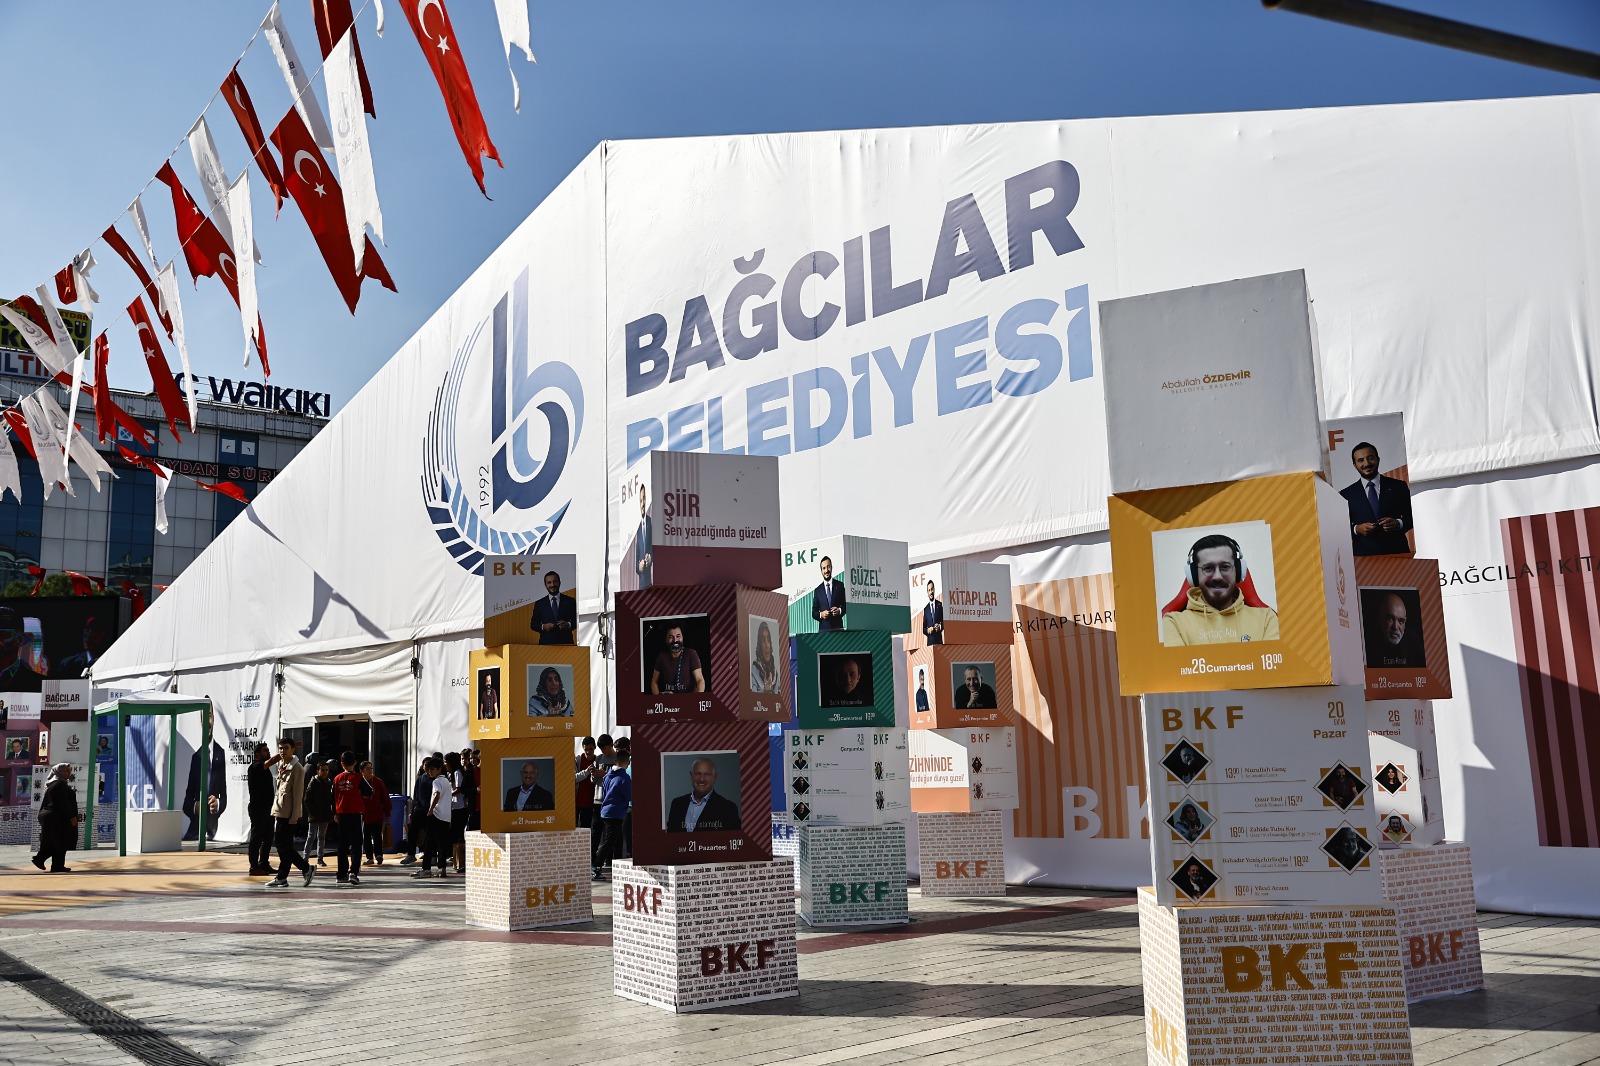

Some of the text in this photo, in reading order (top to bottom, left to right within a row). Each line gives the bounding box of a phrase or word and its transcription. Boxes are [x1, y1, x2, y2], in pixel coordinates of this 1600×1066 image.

[625, 159, 1085, 397] BAĞCILAR
[1161, 370, 1251, 389] Abdullah ÖZDEMİR
[228, 466, 281, 482] SÜR
[479, 465, 490, 509] 1992
[663, 489, 700, 521] ŞİİR
[664, 524, 767, 541] Sen yazdığında güzel!
[785, 548, 818, 567] BKF
[493, 562, 541, 576] BKF
[850, 565, 881, 587] GÜZEL
[1440, 561, 1549, 587] BAĞCILAR
[949, 588, 998, 606] KİTAPLAR
[1027, 616, 1068, 632] KİTAP
[1191, 658, 1206, 674] 26
[1206, 662, 1254, 673] Cumartesi
[45, 693, 80, 703] BAĞCILAR
[655, 703, 664, 714] 20
[1162, 701, 1345, 731] BKF 20
[1388, 710, 1400, 722] 26
[792, 734, 825, 746] BKF
[873, 734, 889, 745] BKF
[971, 733, 990, 743] BKF
[1313, 729, 1347, 739] Pazar
[909, 754, 953, 772] ZİHNİNDE
[126, 784, 154, 808] KF
[1063, 785, 1150, 839] BK
[772, 823, 796, 840] KF
[688, 841, 697, 852] 21
[473, 847, 501, 869] BKF
[936, 860, 989, 879] BKF
[525, 883, 577, 908] BKF
[623, 883, 663, 917] BKF
[829, 881, 891, 904] BKF
[700, 939, 775, 977] BKF
[1408, 930, 1464, 969] BKF
[1220, 942, 1358, 992] BKF
